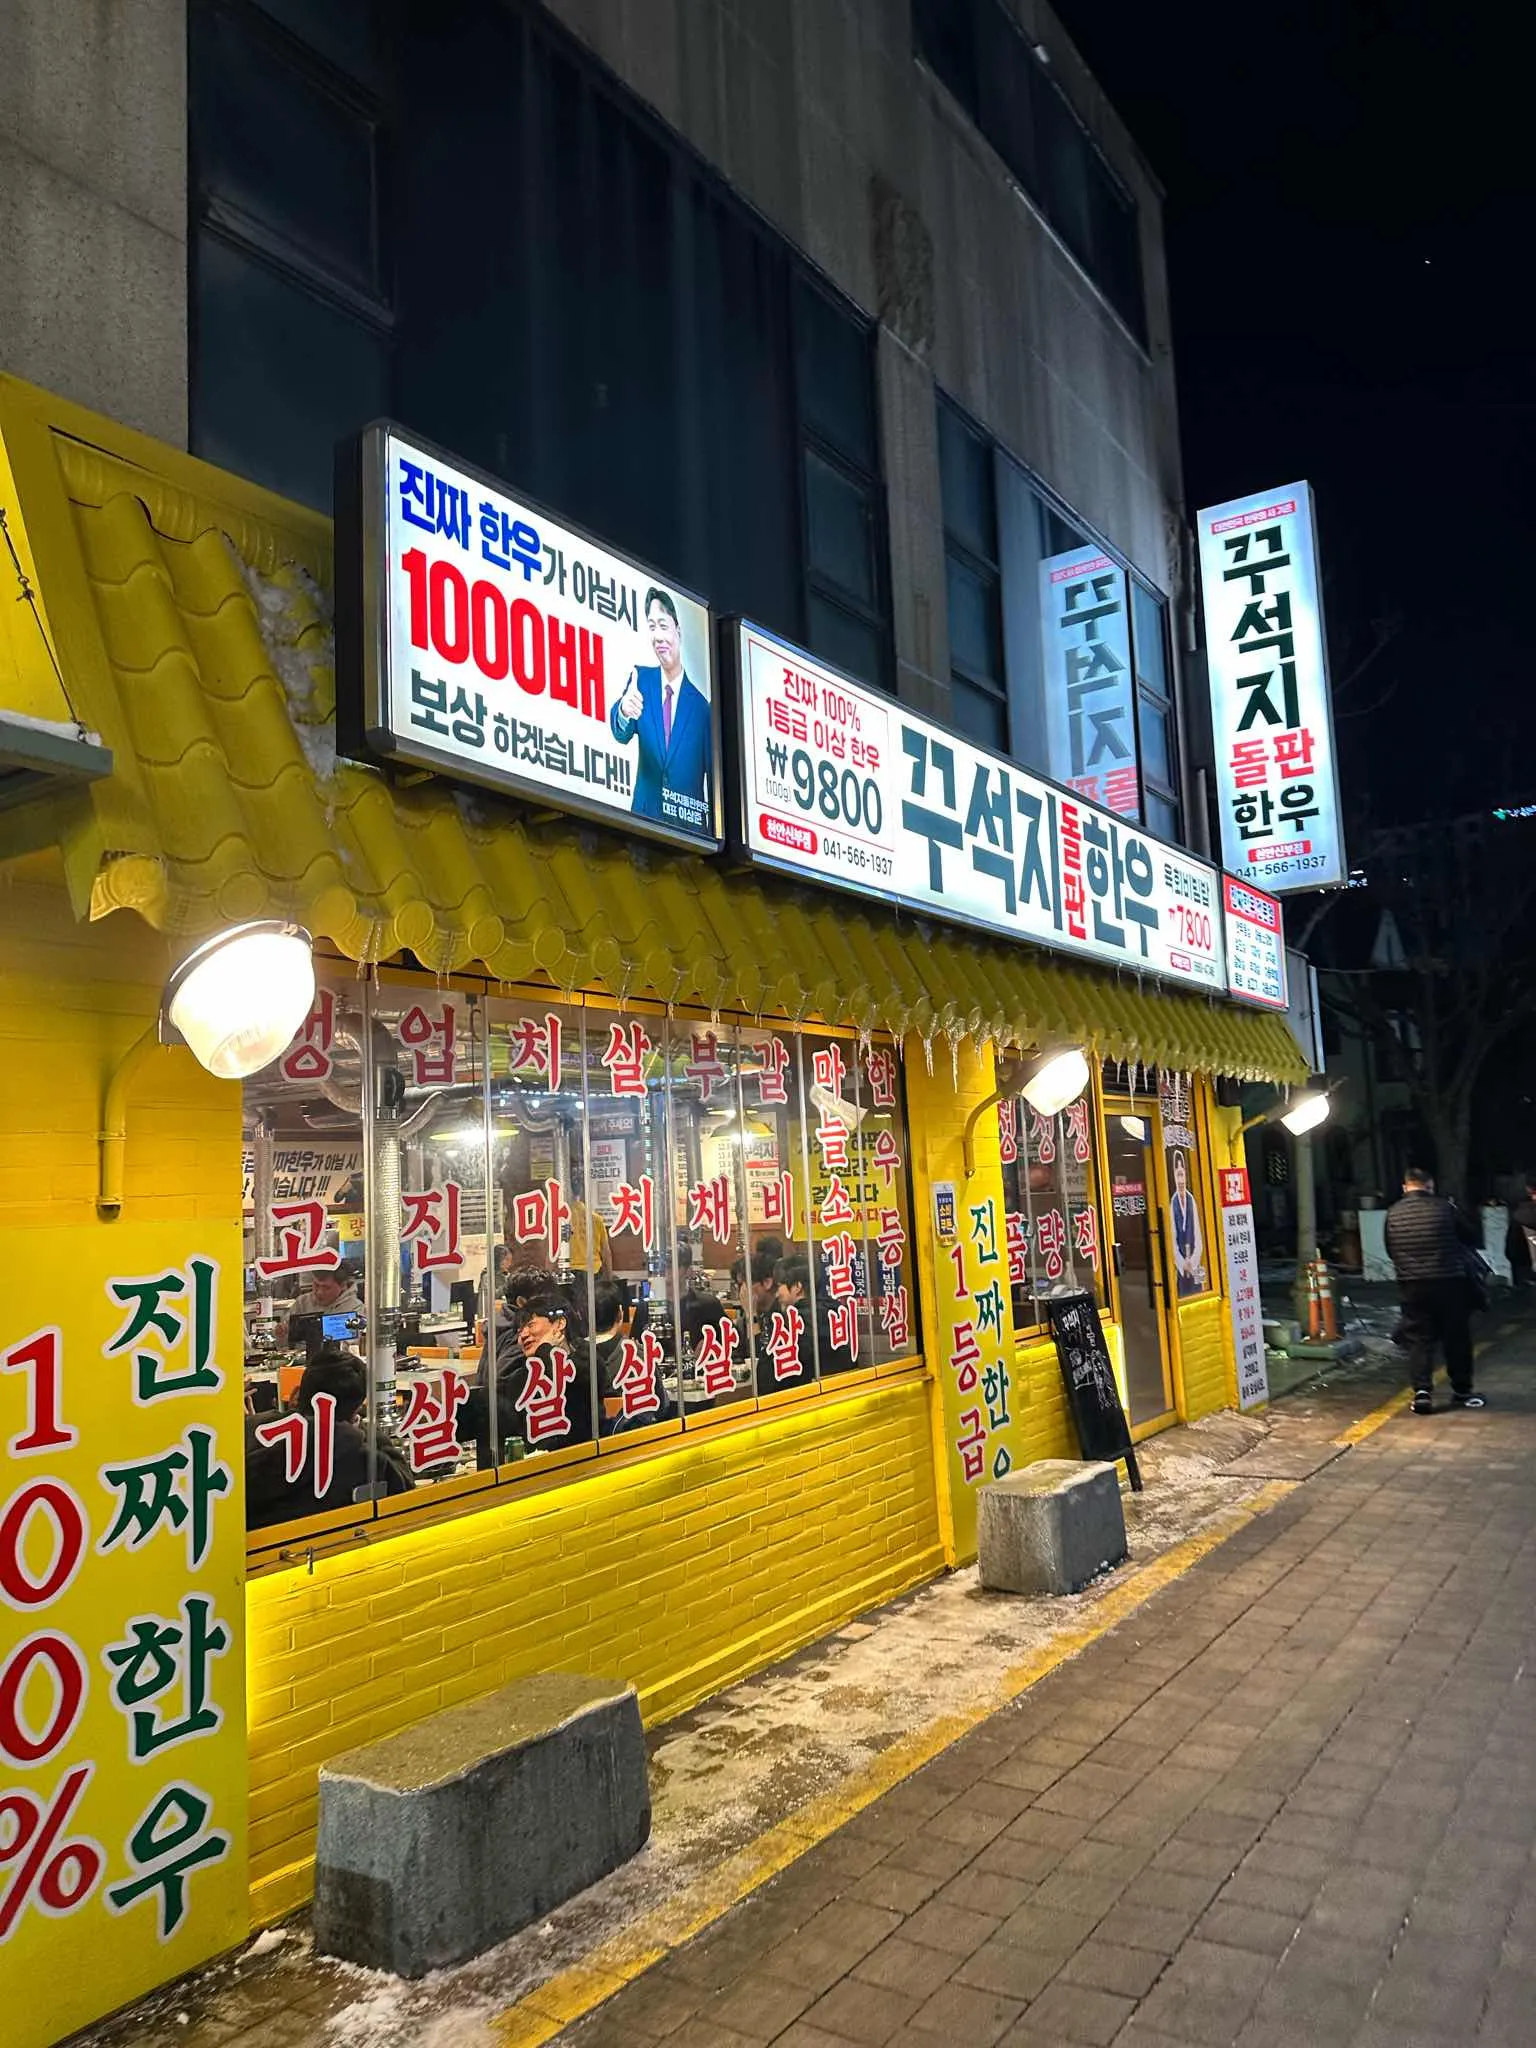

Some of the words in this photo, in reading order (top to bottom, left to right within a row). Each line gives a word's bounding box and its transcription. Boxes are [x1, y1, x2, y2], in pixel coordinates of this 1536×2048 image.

[400, 458, 472, 550] 진짜
[480, 501, 568, 596] 한우가
[573, 560, 639, 632] 아닐시
[402, 546, 606, 723] 1000배
[1223, 524, 1301, 732] 꾸석지
[783, 667, 818, 711] 진짜
[822, 688, 861, 732] 100%
[410, 668, 488, 749] 보상
[493, 711, 632, 797] 하겠습니다!!!
[766, 697, 808, 743] 1등급
[814, 721, 846, 759] 이상
[850, 735, 881, 774] 한우
[1229, 727, 1316, 788] 돌판
[662, 801, 678, 817] 대표
[765, 777, 792, 803] (100g)
[1231, 783, 1320, 841] 한우
[823, 837, 893, 877] 041-566-1937
[901, 724, 1064, 931] 꾸석지
[1060, 800, 1087, 941] 돌판
[1082, 812, 1160, 958] 한우
[1235, 854, 1328, 879] 041-566-1937
[271, 1150, 324, 1173] 짜한우가
[811, 1183, 879, 1206] 걸니다
